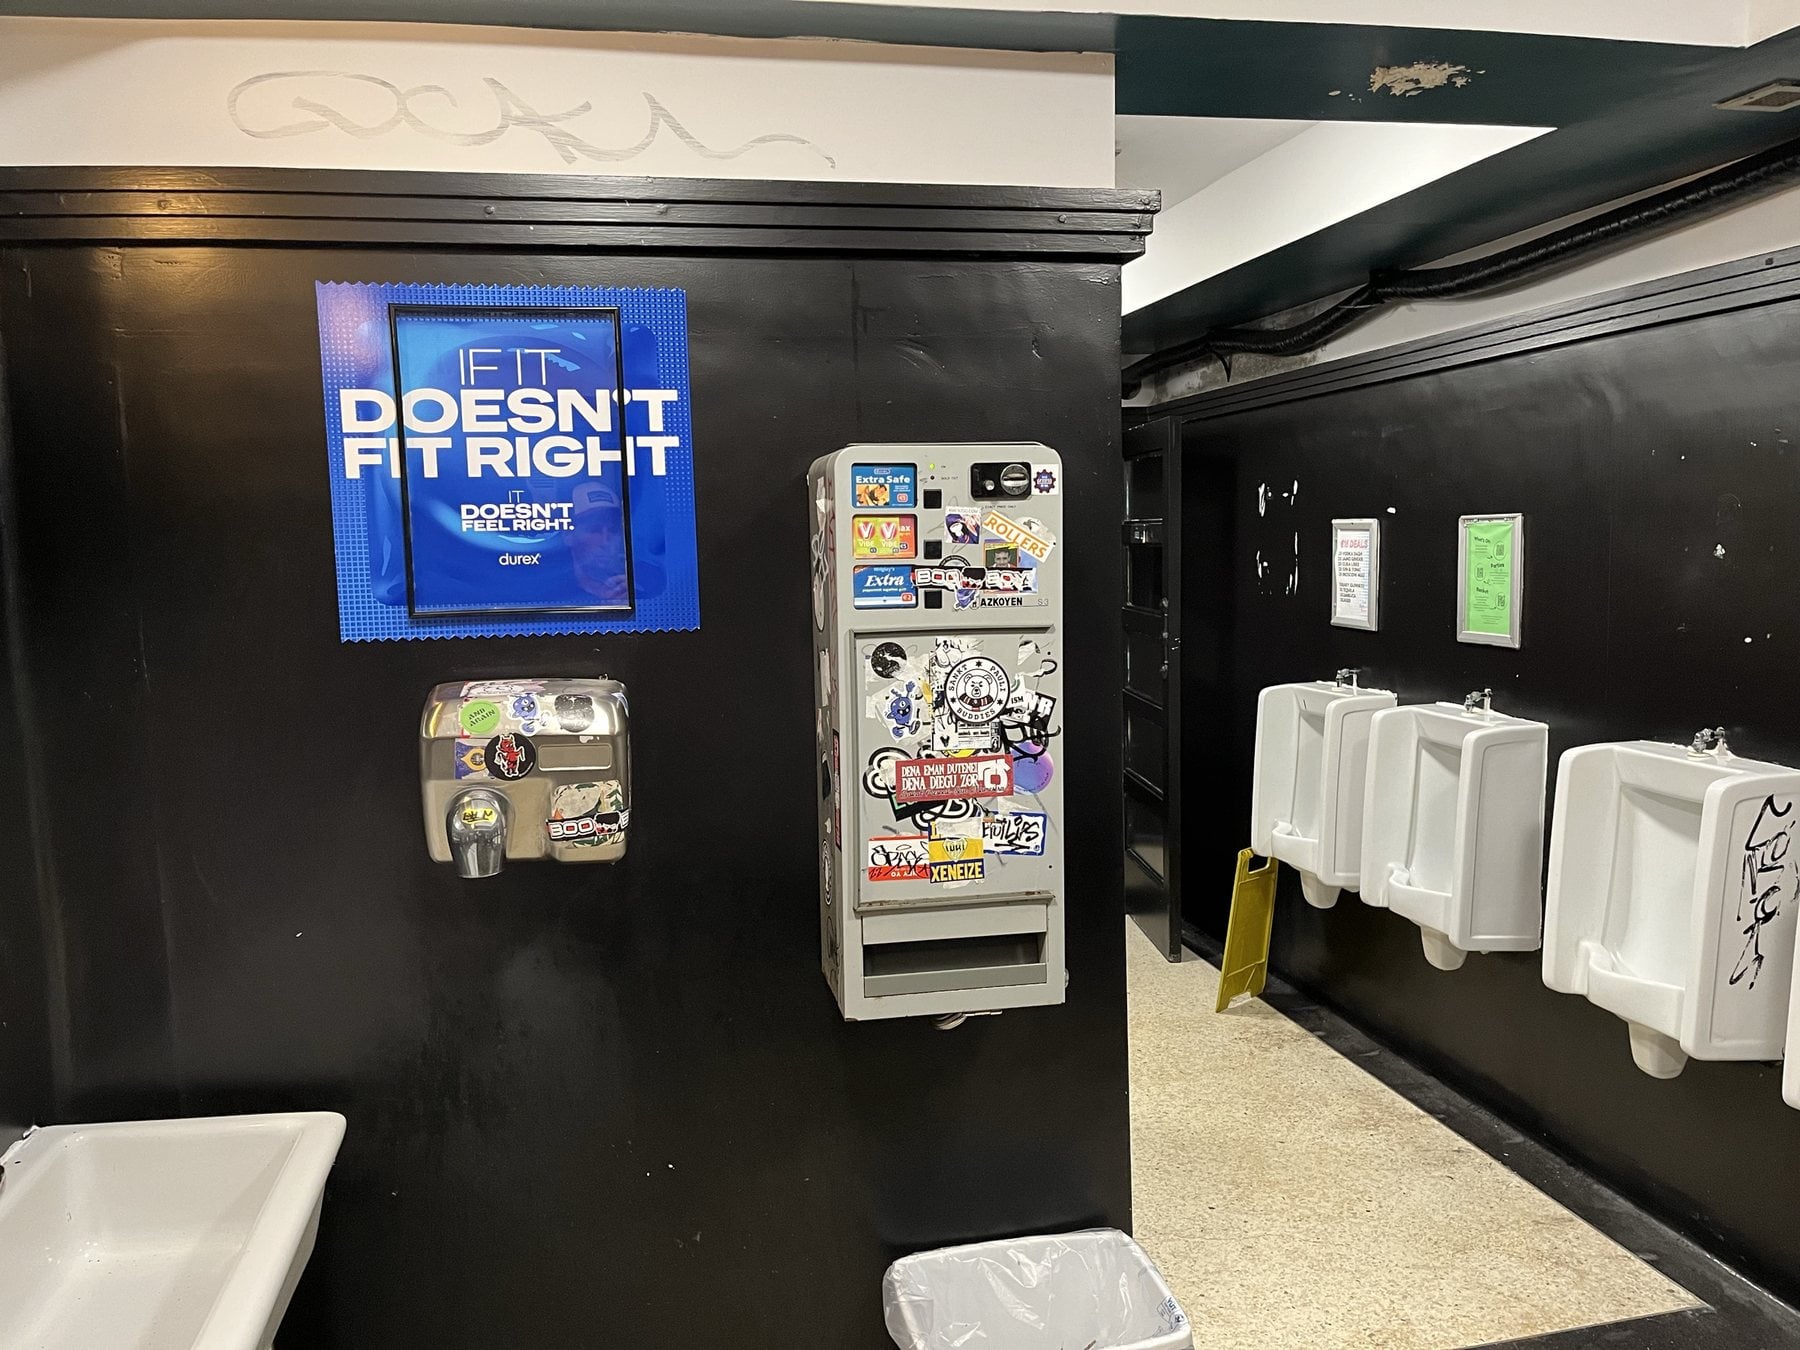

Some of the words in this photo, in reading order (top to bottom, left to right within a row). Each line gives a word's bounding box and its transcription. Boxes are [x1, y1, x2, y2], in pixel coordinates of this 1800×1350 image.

[459, 349, 501, 385] IF
[516, 349, 561, 385] IT
[339, 388, 679, 433] DOESN'T
[343, 437, 452, 479] FIT
[465, 436, 680, 478] RIGHT
[855, 475, 885, 484] Extra
[886, 475, 911, 484] Safe
[508, 490, 524, 504] IT
[460, 503, 574, 519] DOESN'T
[461, 519, 512, 532] FEEL
[513, 518, 575, 532] RIGHT.
[984, 516, 1048, 558] ROLLERS
[498, 553, 540, 566] durex
[864, 573, 905, 587] Extra
[980, 597, 1023, 607] AZKOYEN
[948, 664, 968, 692] SANKT
[989, 665, 1007, 692] PAULI
[956, 708, 996, 720] BUDDIES
[901, 765, 921, 777] DENA
[923, 764, 944, 776] EMAN
[902, 776, 927, 791] DENA
[929, 774, 957, 789] DIEGU
[960, 773, 980, 788] ZOR
[930, 865, 984, 883] XENEIZE
